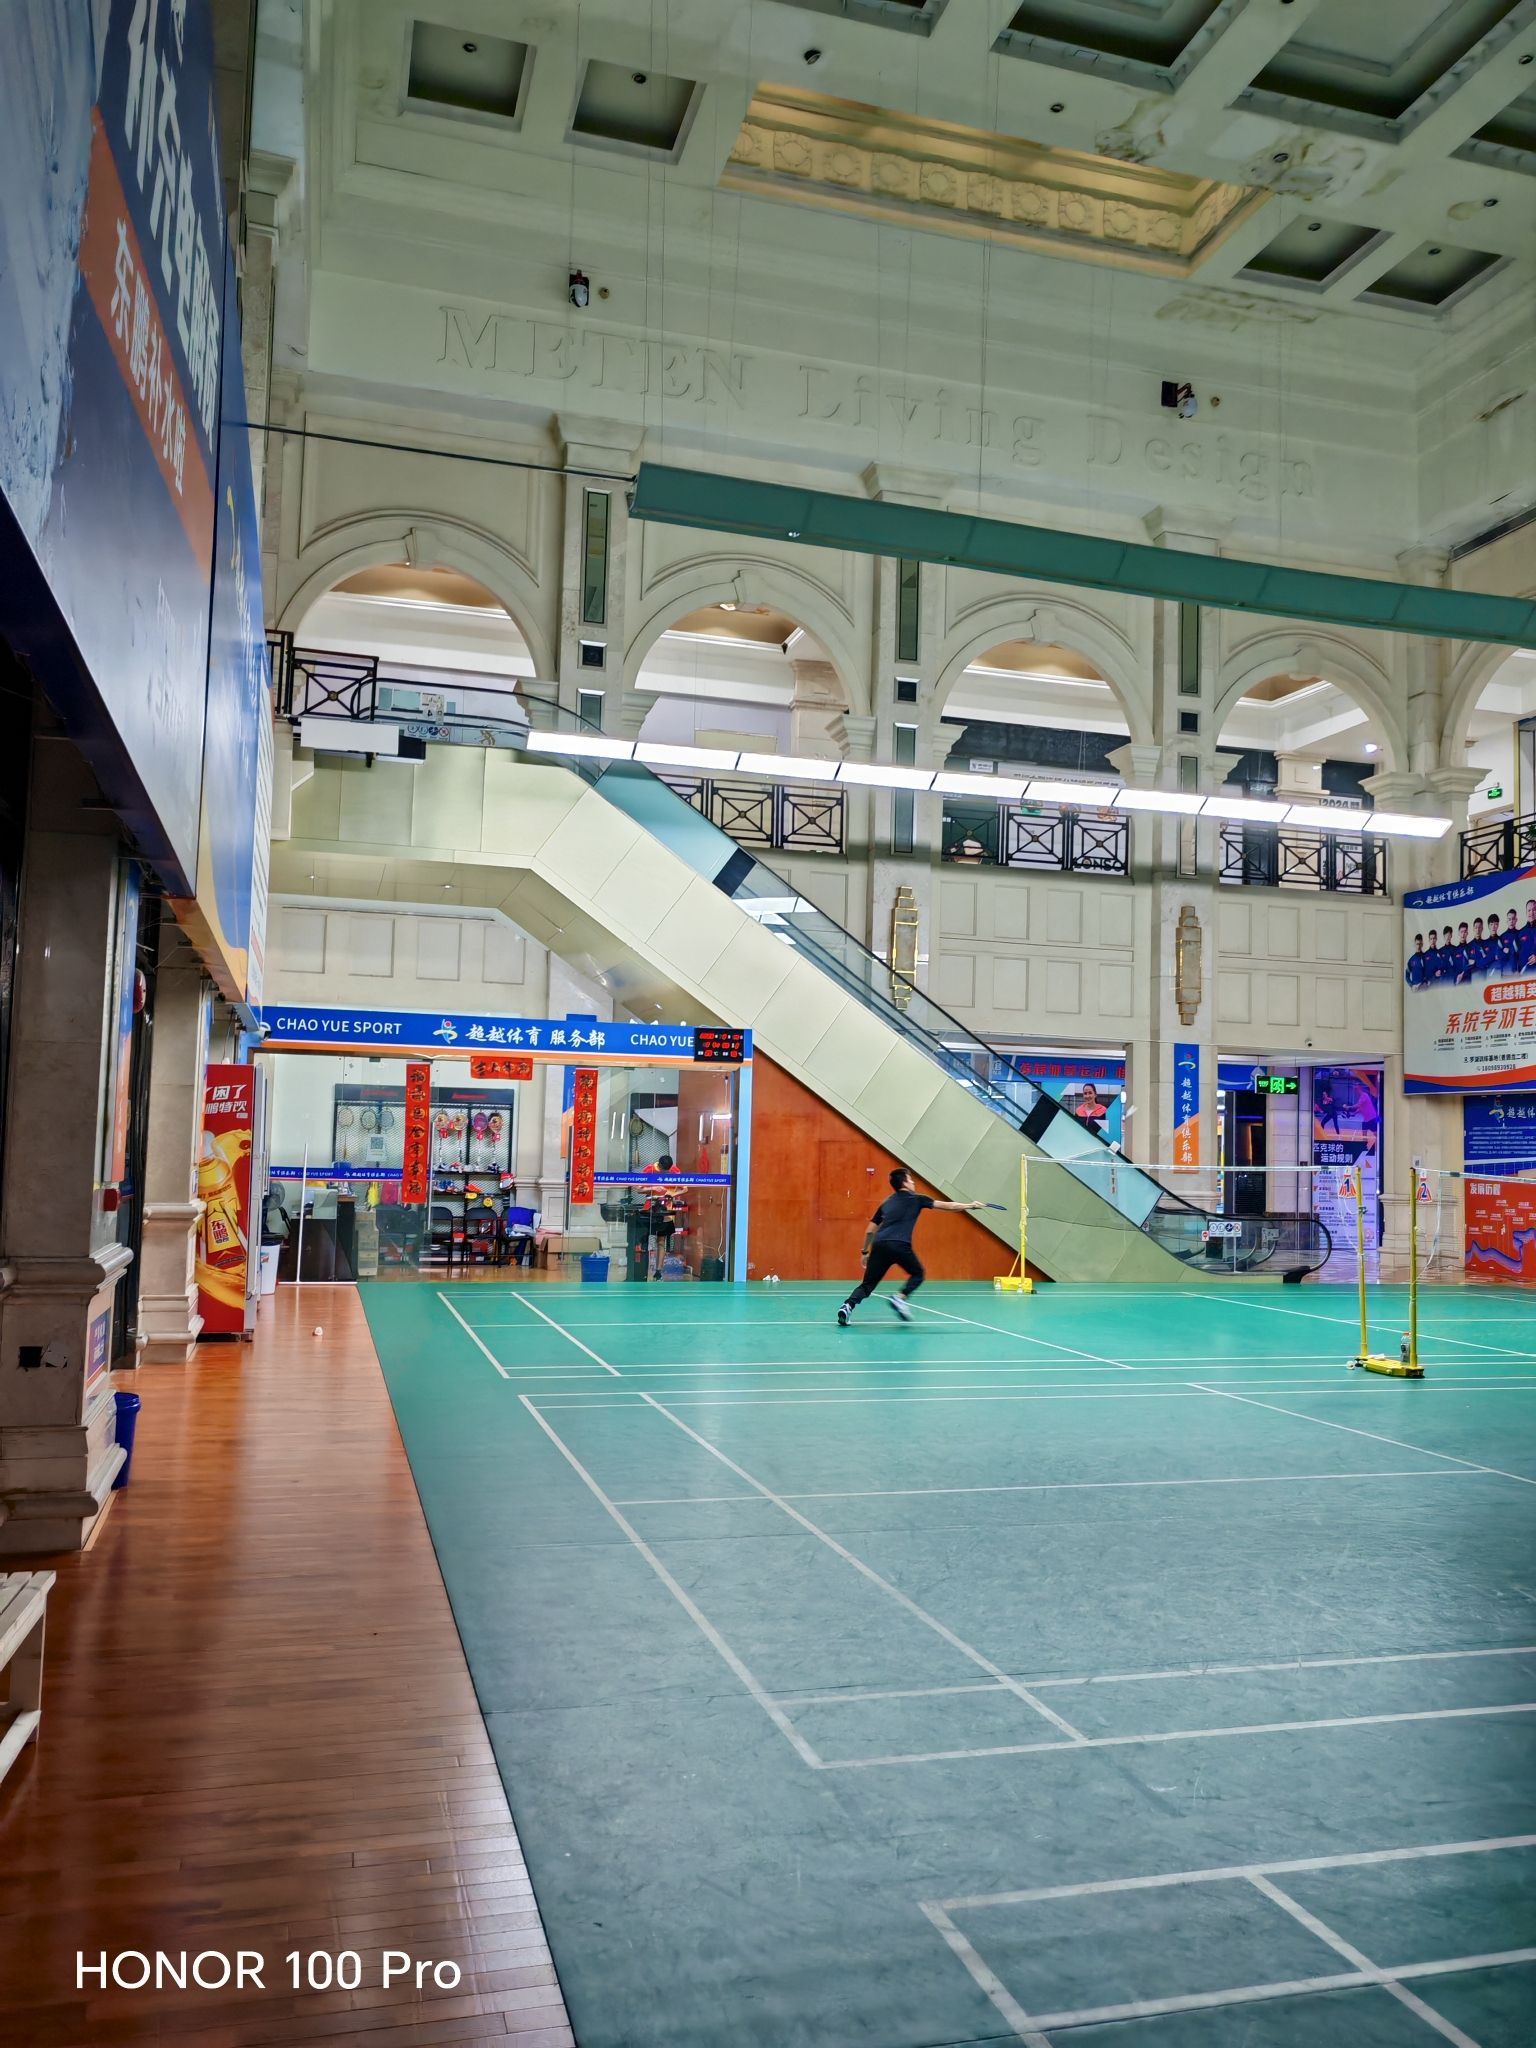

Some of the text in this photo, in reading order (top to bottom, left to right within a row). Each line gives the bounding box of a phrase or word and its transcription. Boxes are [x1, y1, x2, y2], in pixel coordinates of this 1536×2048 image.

[436, 306, 1314, 501] METEN Living Design
[276, 1018, 402, 1035] CHAO YUE SPORT
[465, 1023, 606, 1050] 超越体育 服务部
[630, 1033, 667, 1046] CHAO
[670, 1035, 695, 1047] YUE
[1180, 1077, 1193, 1165] 超越体育俱乐部
[1344, 1178, 1351, 1192] 1
[1421, 1183, 1427, 1198] 2
